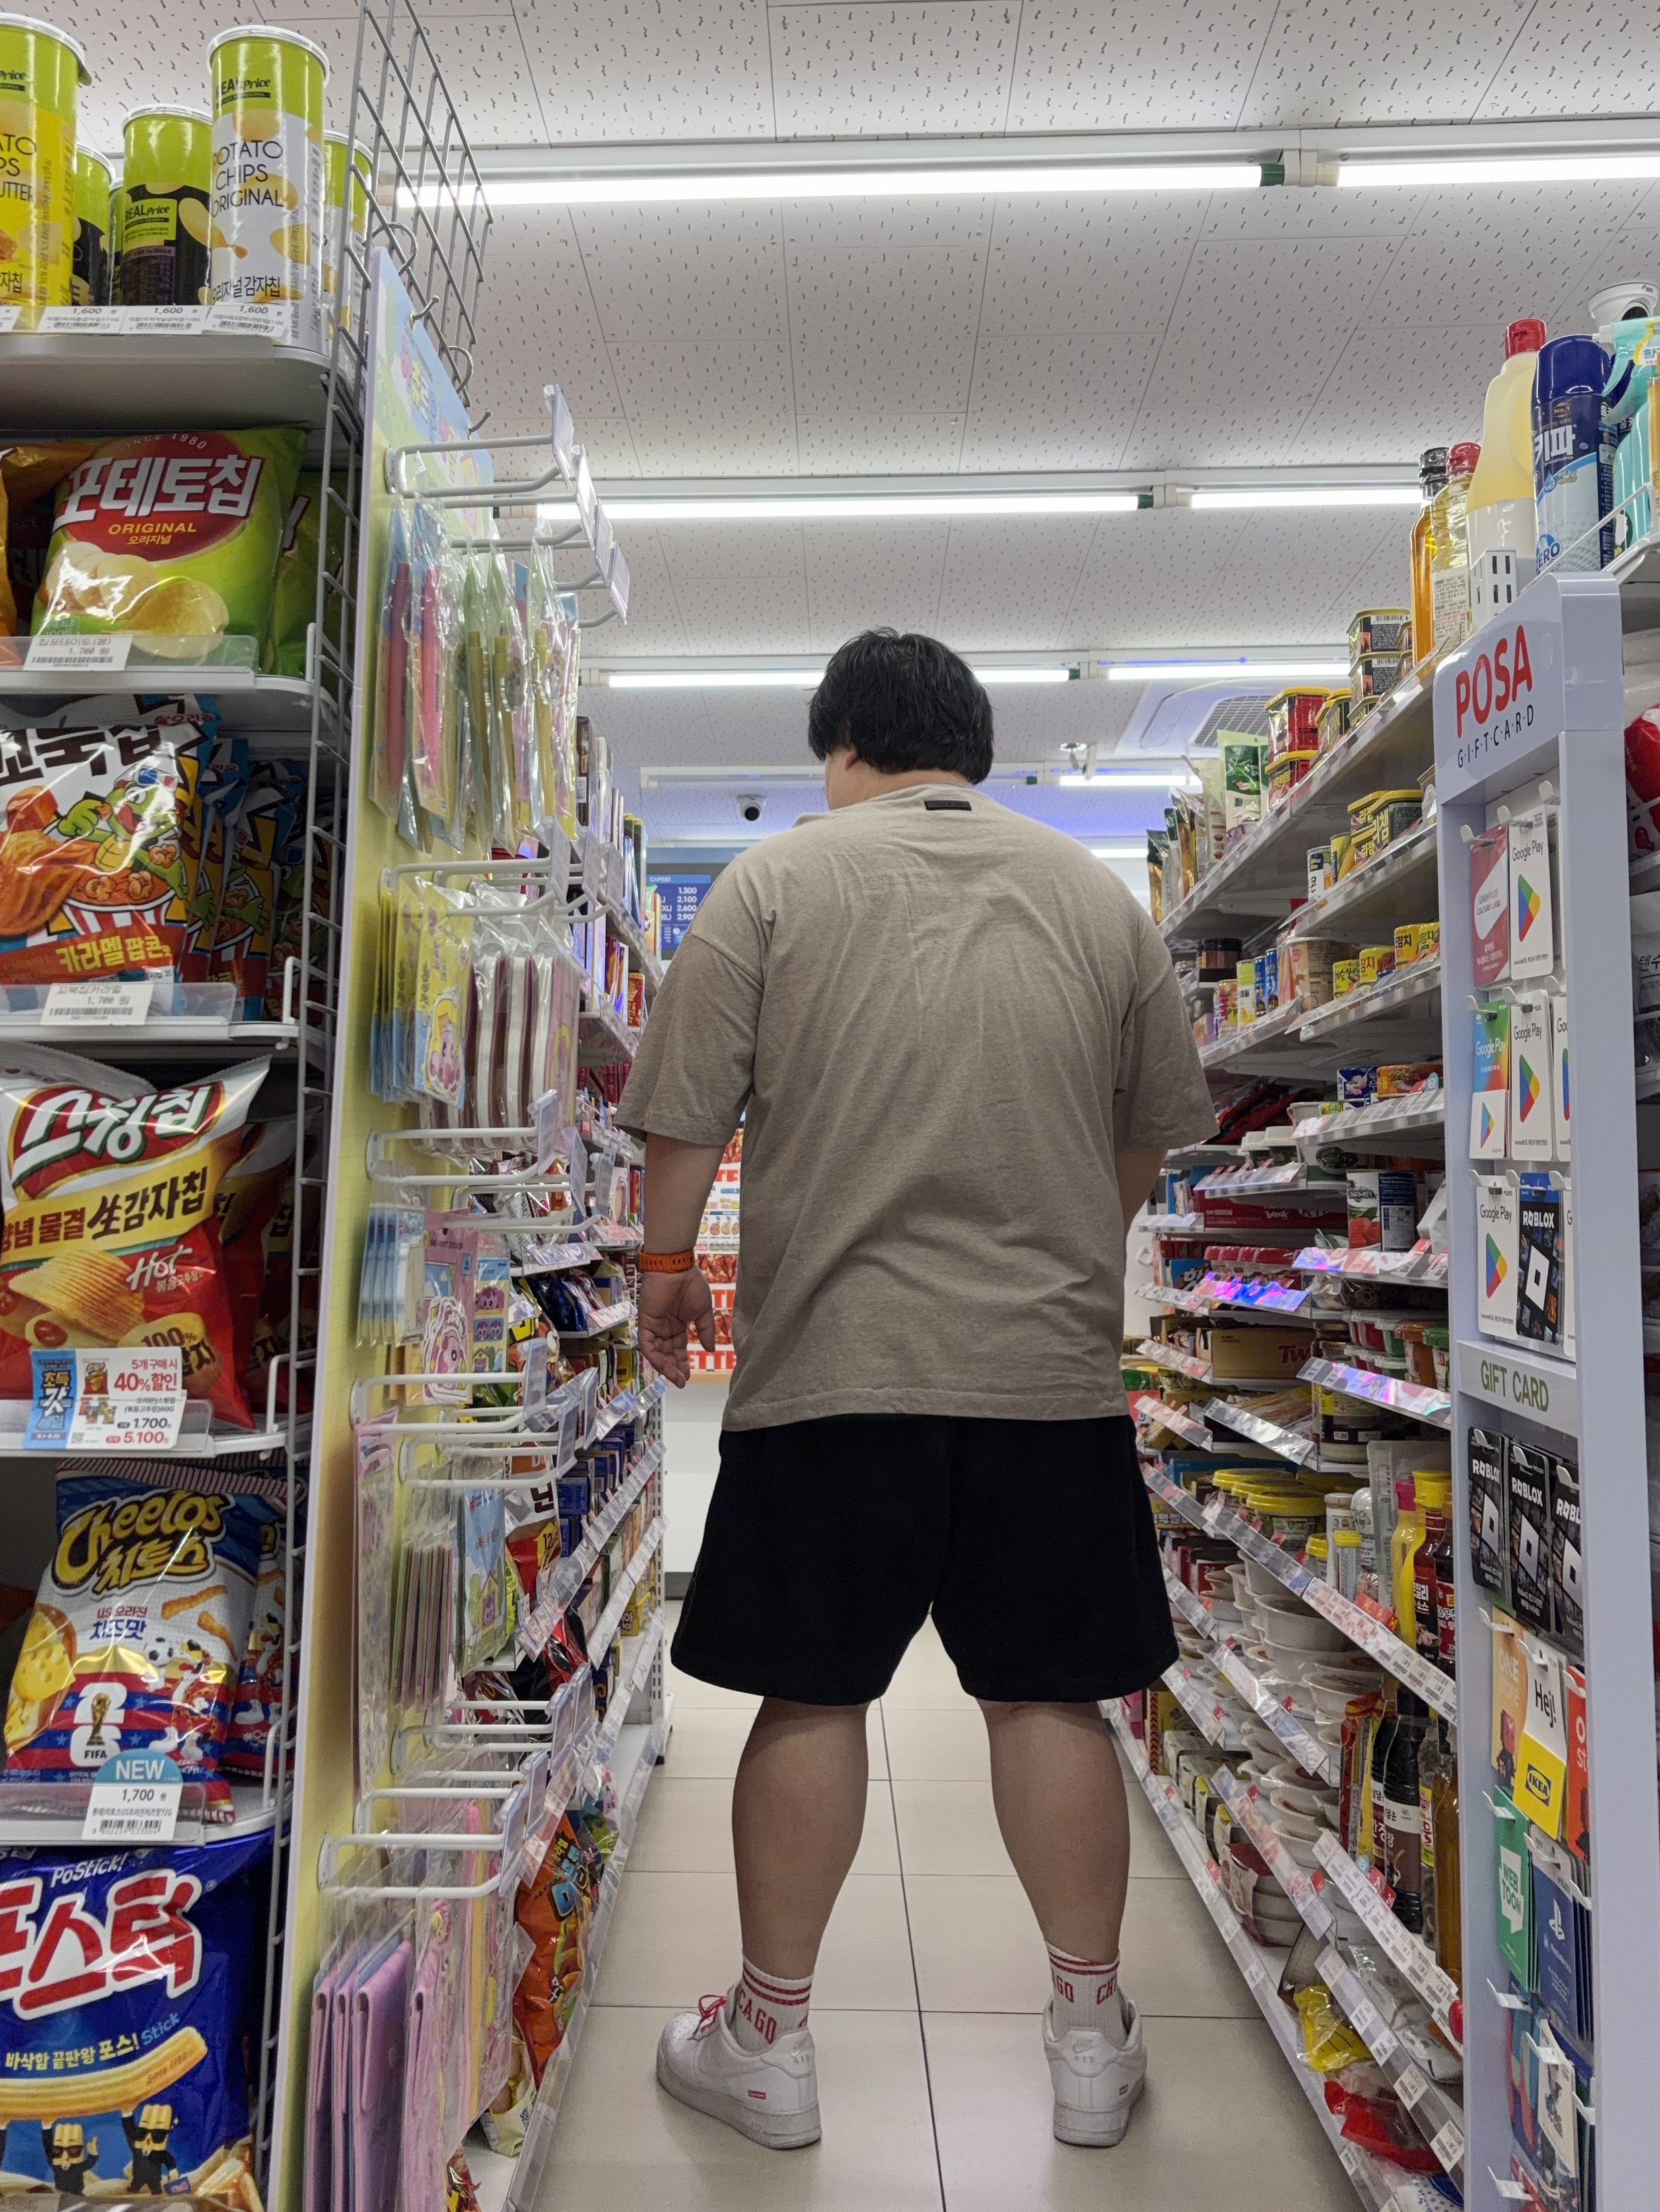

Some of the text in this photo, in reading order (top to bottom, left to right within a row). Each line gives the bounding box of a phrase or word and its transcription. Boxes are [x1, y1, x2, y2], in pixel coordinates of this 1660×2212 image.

[0, 134, 37, 155] TO
[213, 139, 283, 166] POTATO
[215, 164, 269, 191] CHIPS
[211, 188, 284, 218] ORIGINAL
[244, 275, 281, 298] 감자칩
[73, 307, 102, 315] 1,600
[154, 307, 183, 315] 1,600
[239, 306, 268, 315] 1,600
[171, 433, 209, 450] 1980
[52, 454, 262, 533] 포테토칩
[108, 522, 198, 535] ORIGINAL
[127, 534, 172, 546] 오리지널
[1455, 624, 1533, 739] POSA
[1512, 839, 1544, 862] Google Play
[677, 896, 697, 904] 2,100
[55, 935, 126, 974] 카라멜
[87, 996, 115, 1005] 1,700
[1514, 1022, 1542, 1042] Google Play
[1476, 1037, 1507, 1059] Google Play
[1480, 1204, 1513, 1224] Google Play
[1523, 1210, 1555, 1229] ROBLOX
[39, 1207, 86, 1244] 물결
[126, 1244, 193, 1291] Hot
[141, 1326, 197, 1348] 100%
[132, 1358, 178, 1369] 5개 구매 시
[114, 1372, 177, 1391] 40% 할인
[1481, 1359, 1549, 1413] GIFT CARD
[133, 1417, 168, 1429] 1,700
[123, 1431, 165, 1444] 5,100
[1472, 1458, 1500, 1485] ROBLOX
[1511, 1476, 1544, 1507] ROBLOX
[54, 1489, 230, 1587] Cheetos
[94, 1535, 209, 1594] 치토스
[98, 1606, 112, 1618] US
[89, 1618, 147, 1641] 치즈맛
[1534, 1678, 1557, 1729] Hej!
[84, 1750, 108, 1759] FIFA
[115, 1759, 166, 1781] NEW
[123, 1788, 155, 1803] 1,700
[1529, 1773, 1548, 1797] IKEA
[50, 1852, 128, 1887] PoStick!
[1502, 1862, 1519, 1894] WEB
[1502, 1880, 1521, 1916] TOON
[5, 2013, 180, 2071] 바삭함 끝판왕 포스! Stick
